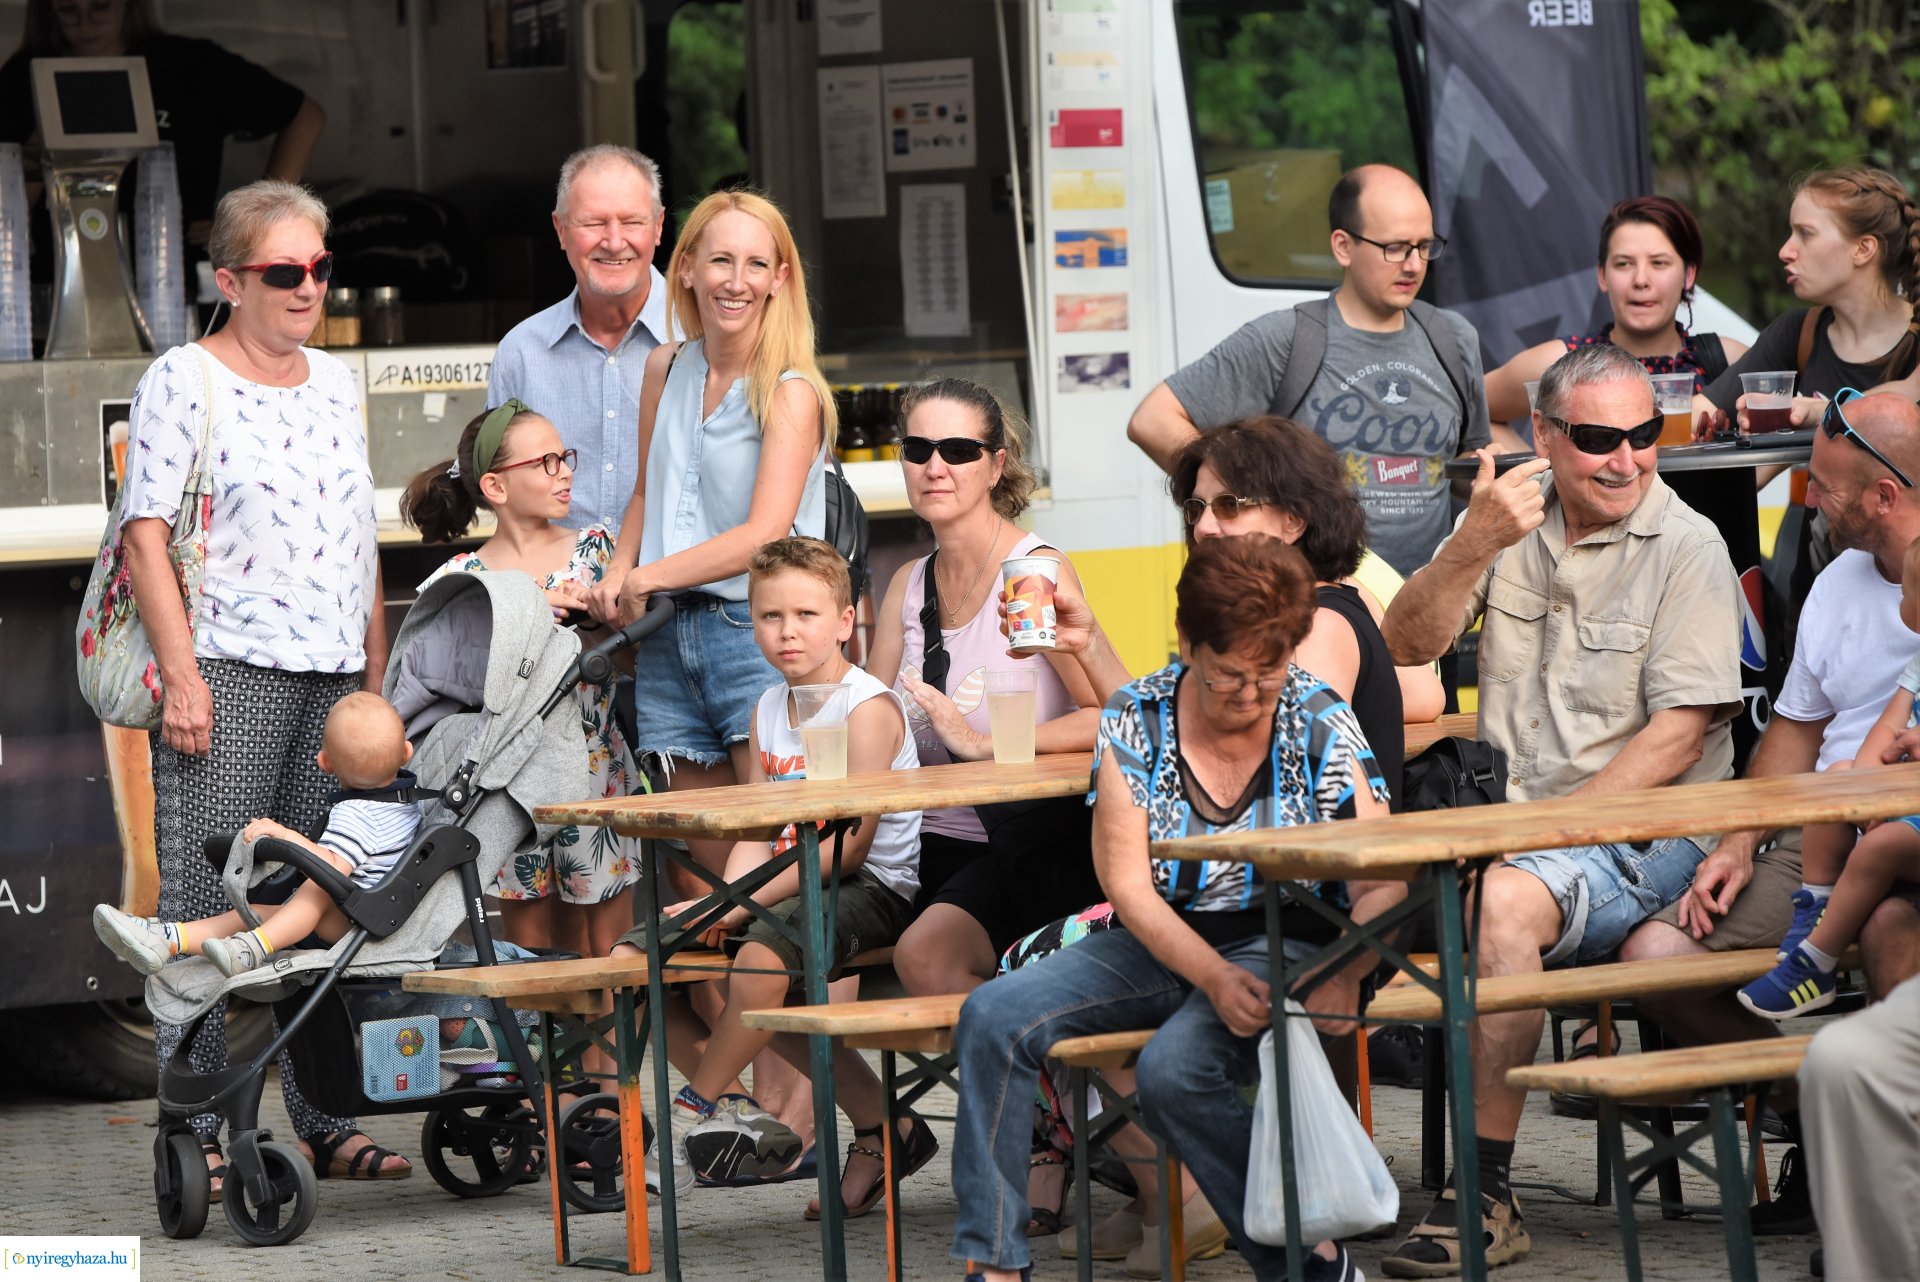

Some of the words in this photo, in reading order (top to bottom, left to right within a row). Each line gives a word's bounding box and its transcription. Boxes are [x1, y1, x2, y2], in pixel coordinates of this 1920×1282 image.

[1377, 459, 1419, 483] Banquet
[1380, 507, 1406, 515] SINCE
[474, 897, 485, 924] rapid
